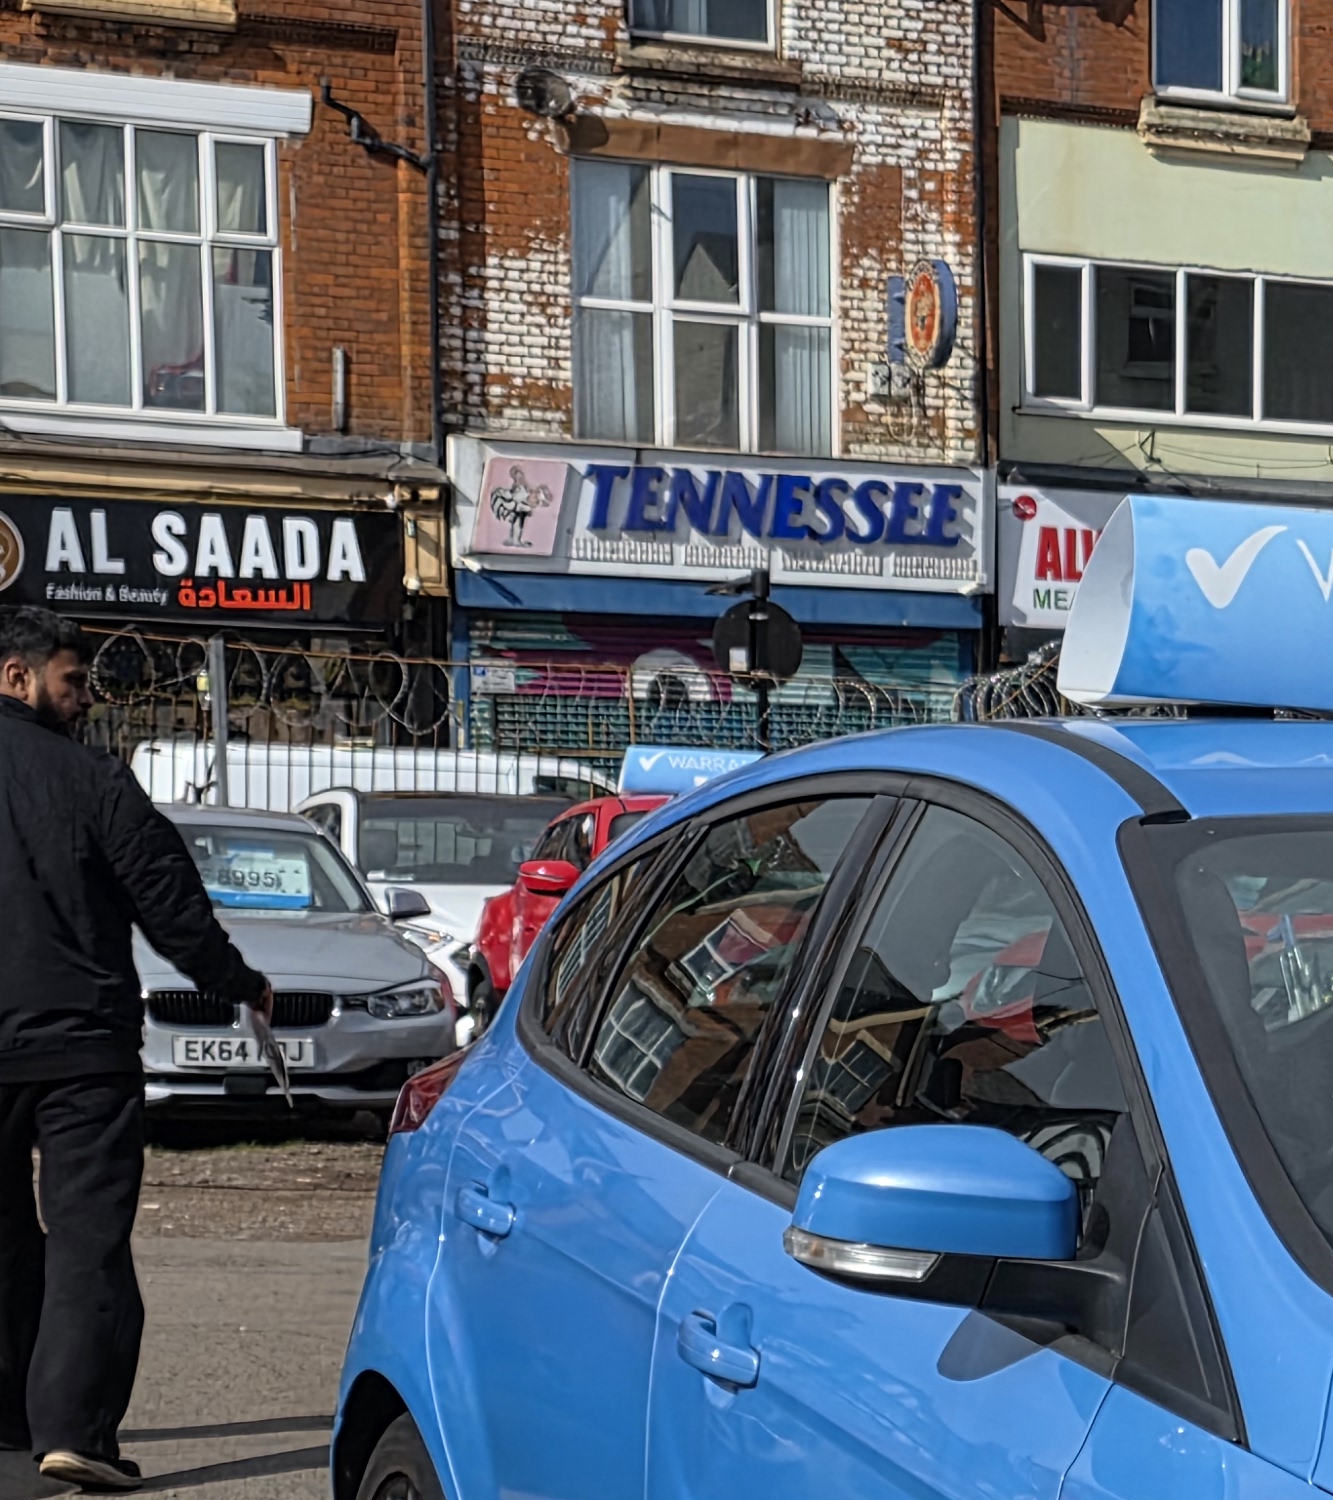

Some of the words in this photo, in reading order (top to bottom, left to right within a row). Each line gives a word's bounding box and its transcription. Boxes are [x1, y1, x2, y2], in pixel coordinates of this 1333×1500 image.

[585, 463, 963, 546] TENNESSEE
[45, 507, 125, 574] AL
[152, 510, 366, 582] SAADA
[1035, 526, 1102, 582] AL
[46, 582, 102, 601] Fashion
[105, 588, 116, 601] &
[119, 585, 168, 606] Beauty
[178, 578, 312, 610] السعادة
[1033, 588, 1076, 611] ME
[668, 755, 749, 773] WARRA
[185, 1040, 248, 1062] EK64
